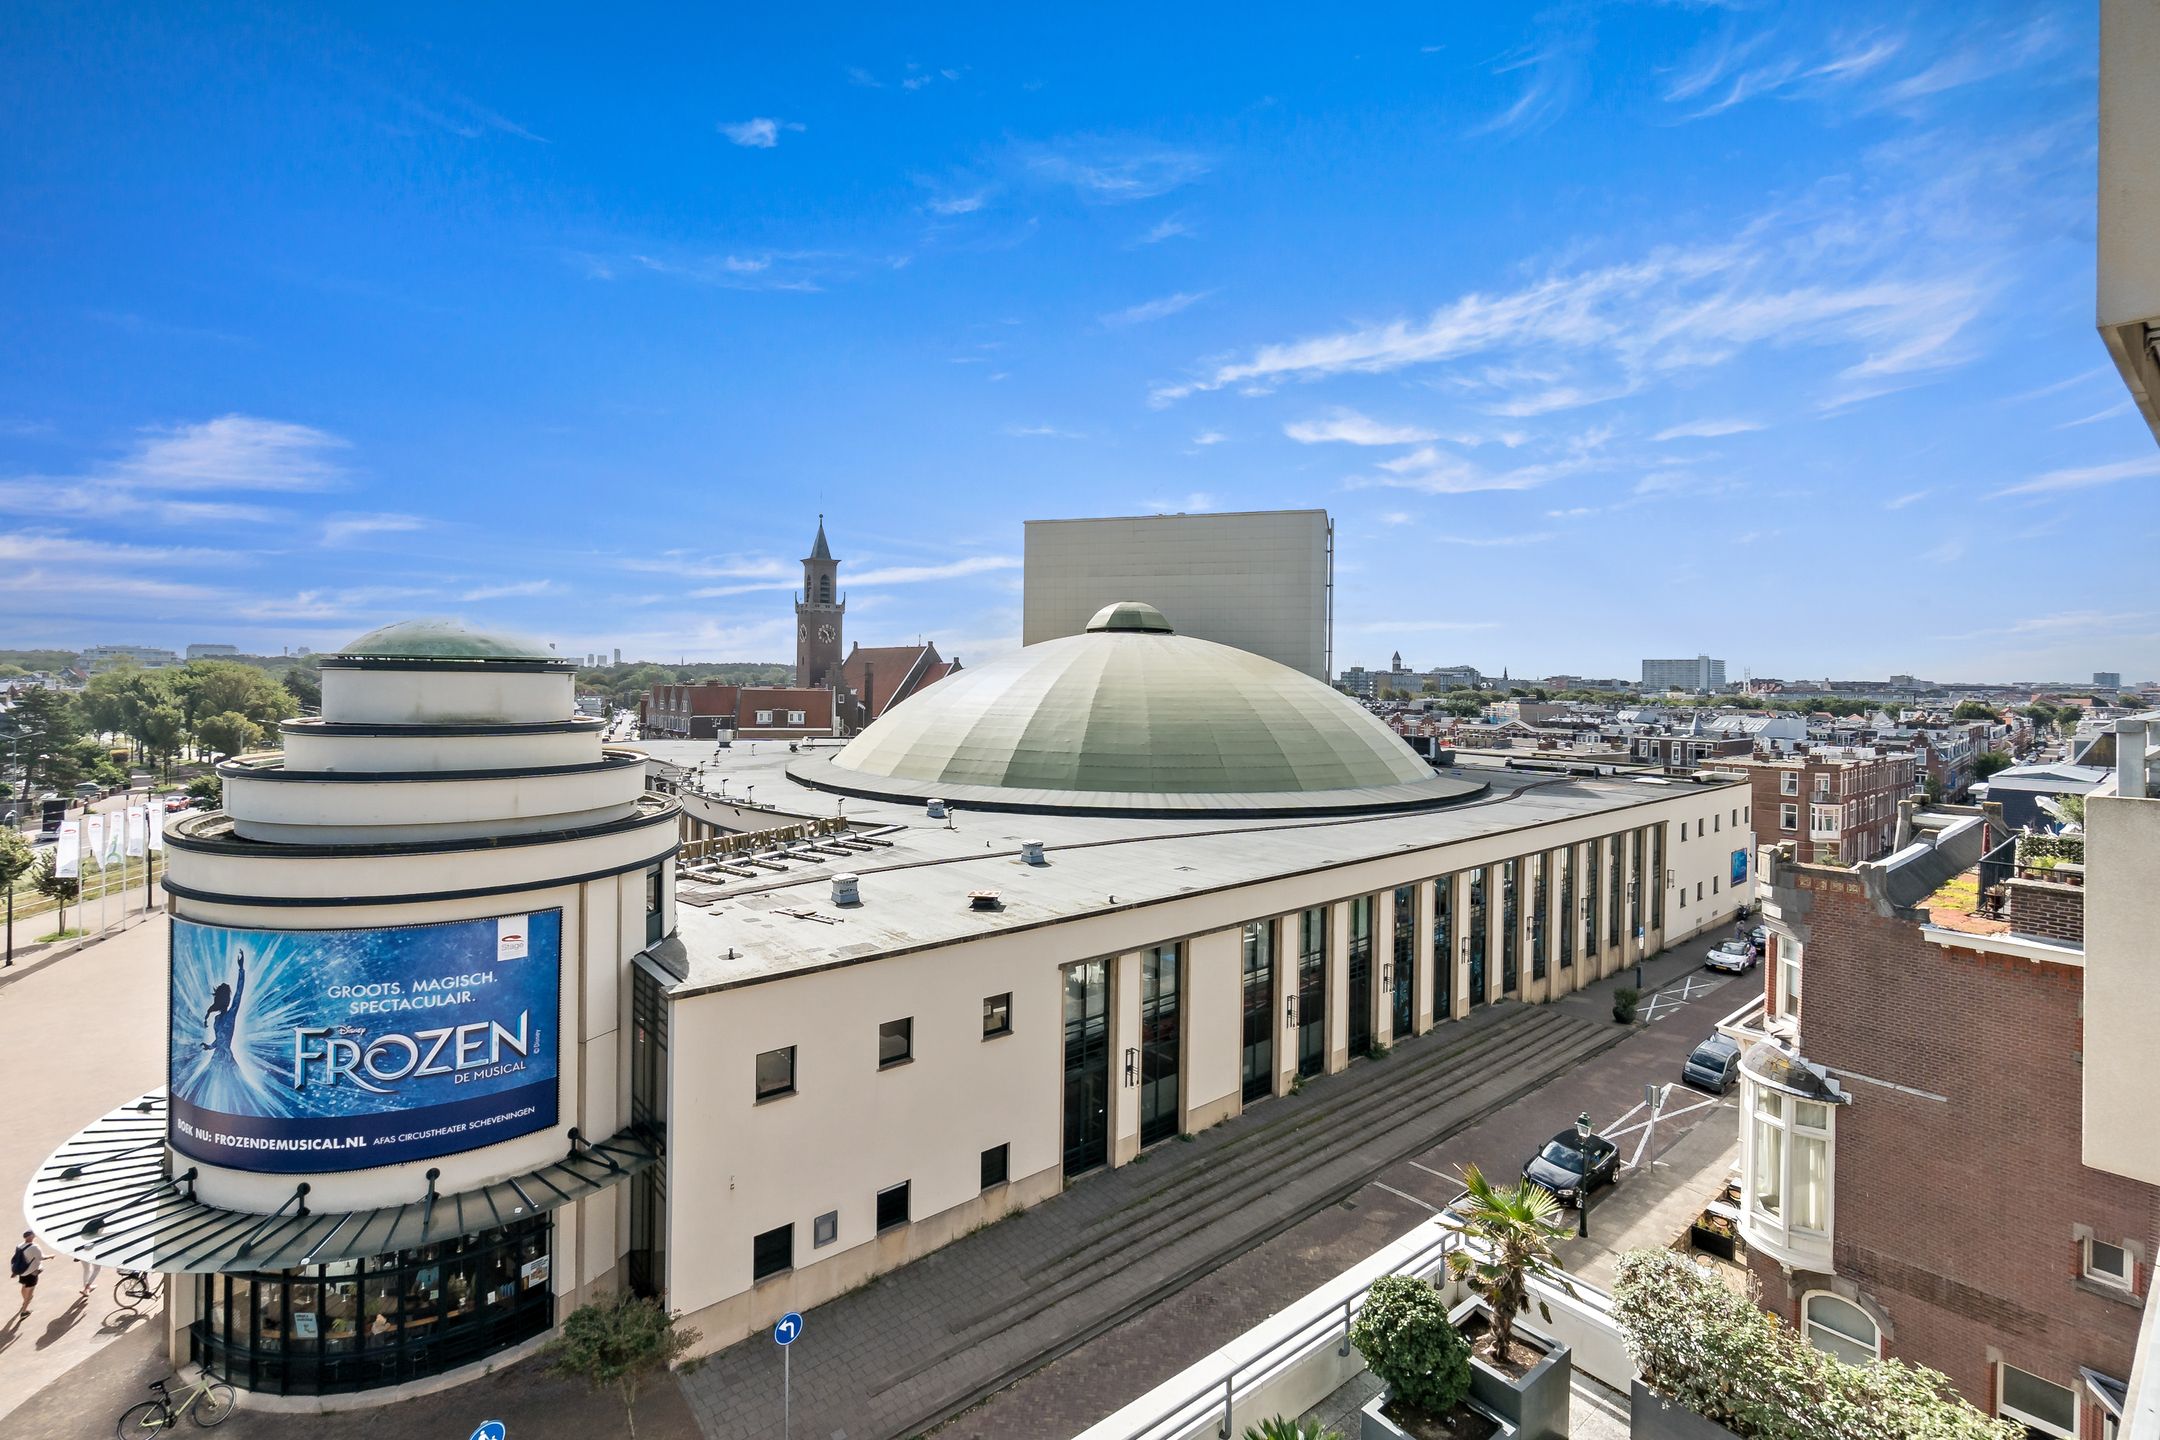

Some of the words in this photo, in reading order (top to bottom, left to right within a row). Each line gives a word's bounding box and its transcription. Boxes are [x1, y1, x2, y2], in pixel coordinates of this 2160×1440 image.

[501, 942, 524, 952] Stage
[328, 982, 406, 999] GROOTS.
[412, 971, 498, 994] MAGISCH.
[350, 990, 476, 1016] SPECTACULAIR.
[454, 1072, 470, 1085] DE
[473, 1060, 527, 1081] MUSICAL
[177, 1118, 194, 1137] BOEK
[195, 1128, 212, 1143] NU:
[214, 1133, 367, 1151] FROZENDEMUSICAL.NL
[373, 1135, 396, 1146] AFAS
[398, 1123, 467, 1143] CIRCUSTHEATER
[469, 1106, 536, 1129] SCHEVENINGEN
